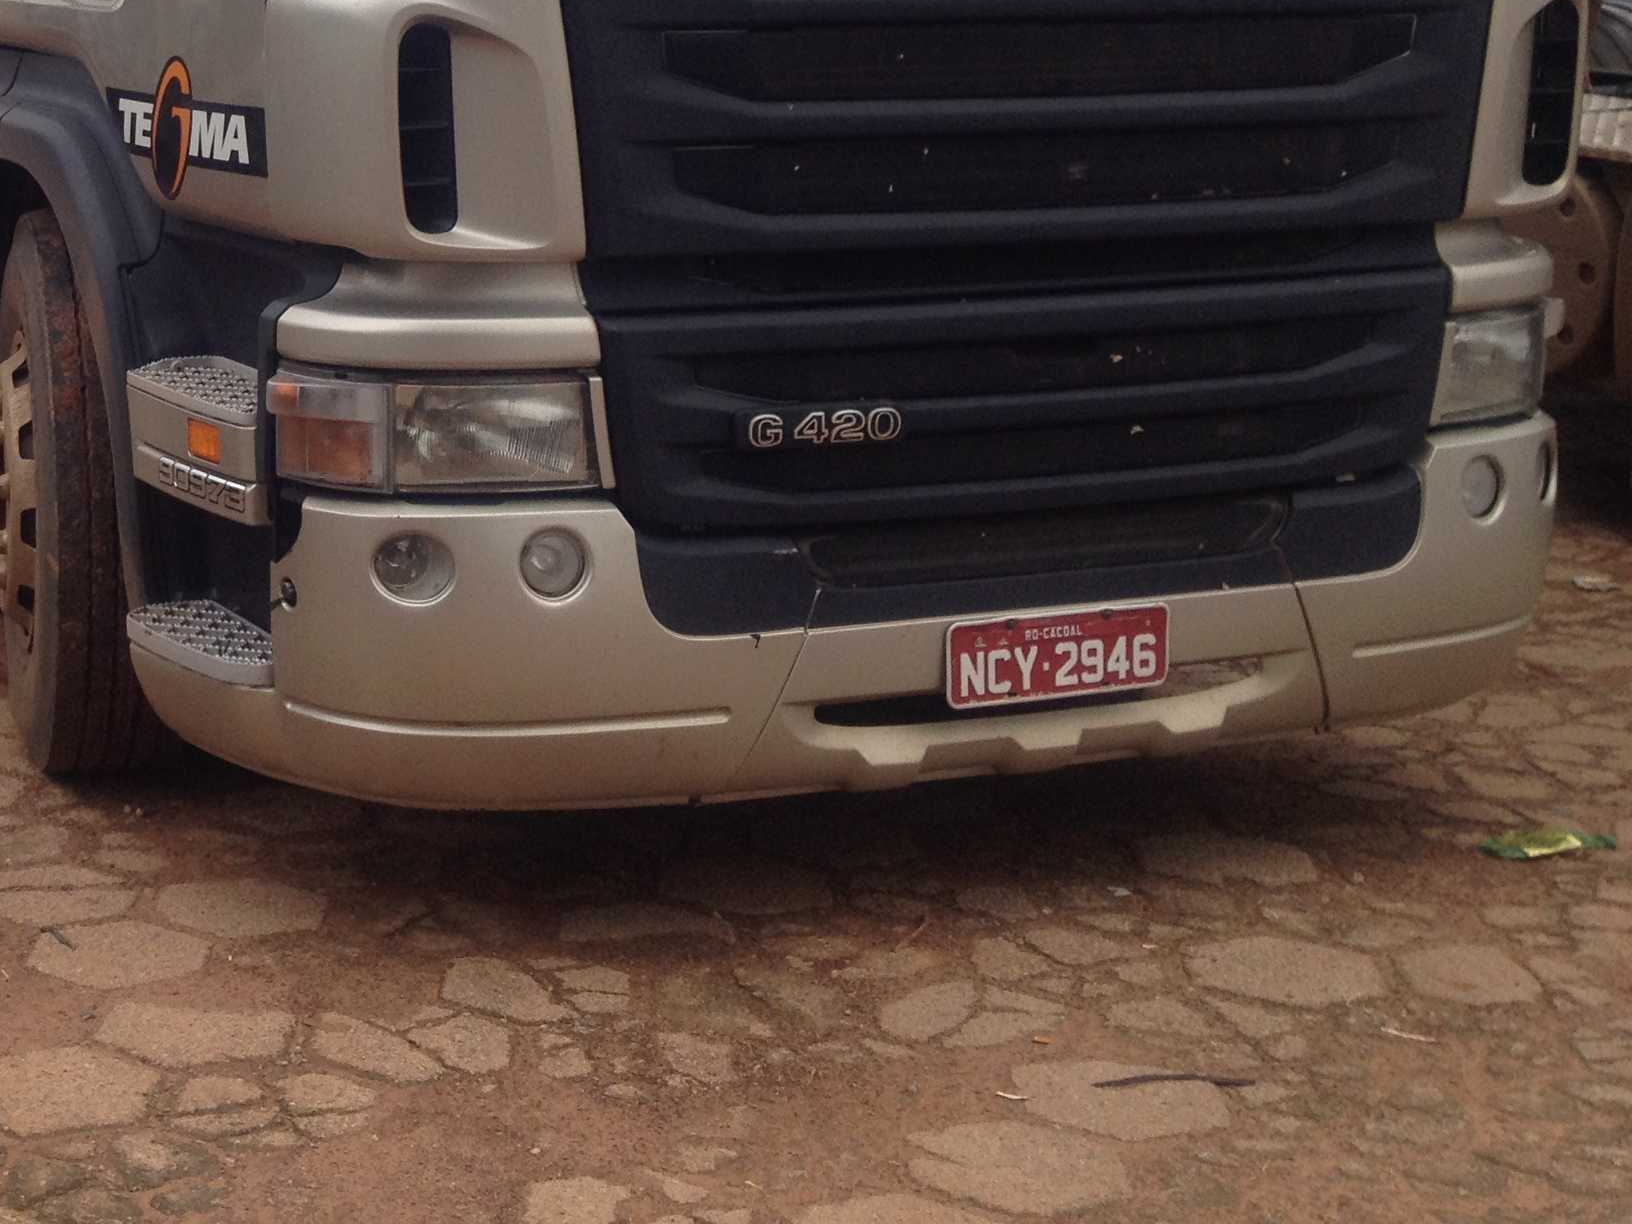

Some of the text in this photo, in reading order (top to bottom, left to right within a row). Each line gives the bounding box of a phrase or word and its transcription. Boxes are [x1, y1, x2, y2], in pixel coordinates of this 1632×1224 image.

[118, 58, 250, 198] TEGMA
[749, 407, 902, 448] G 420
